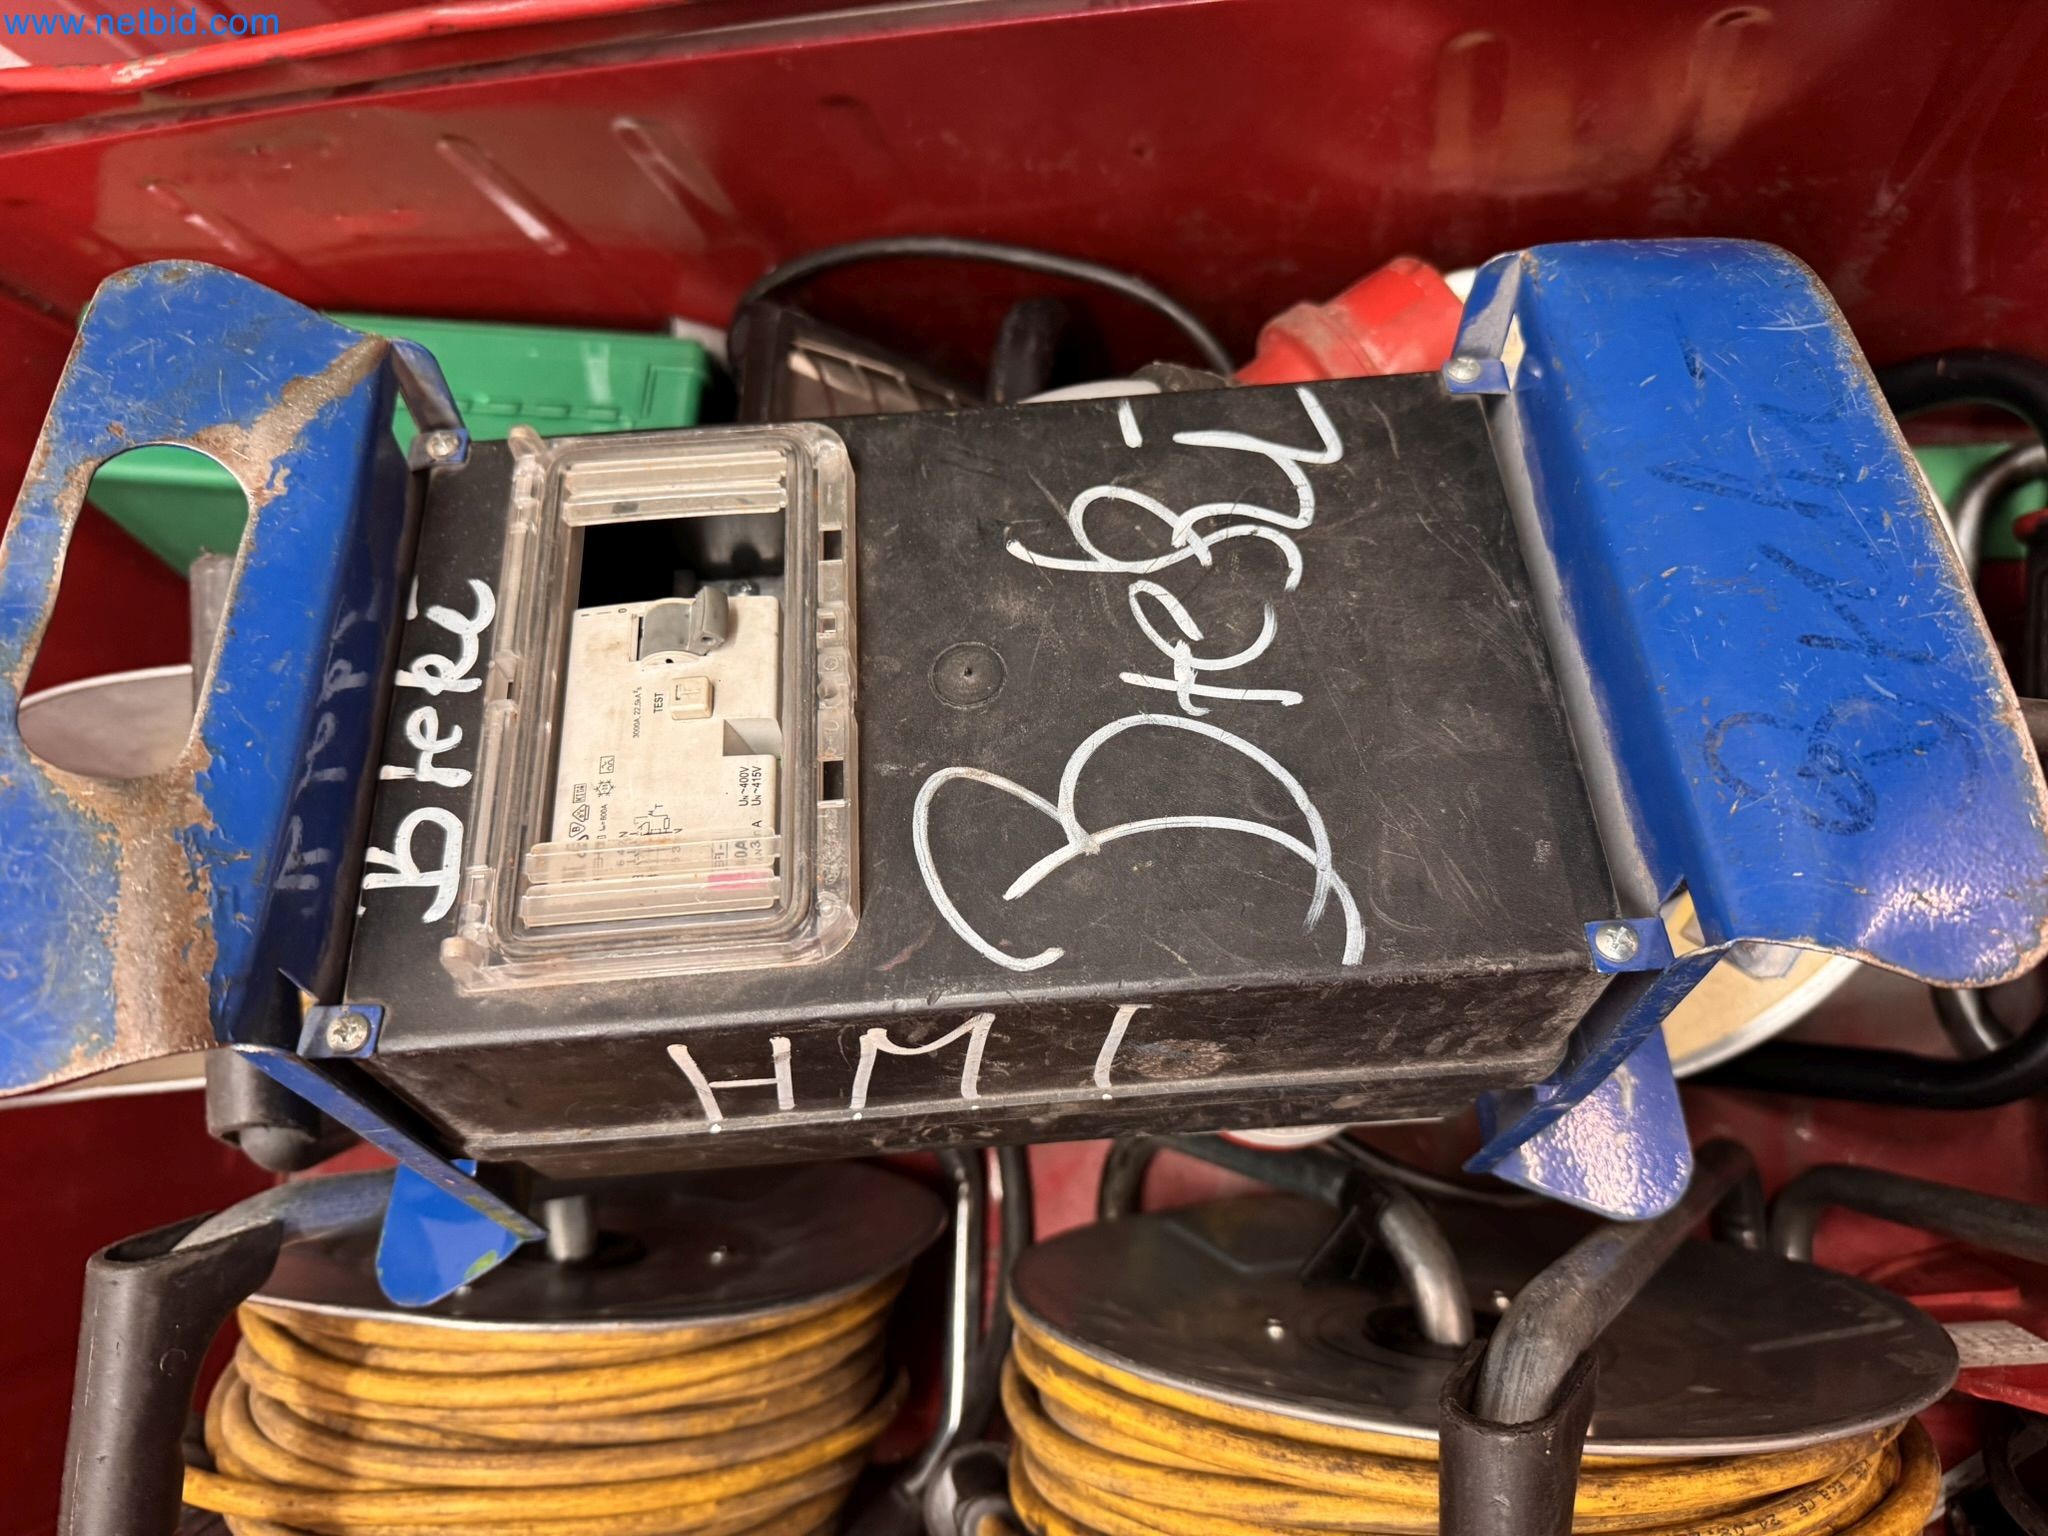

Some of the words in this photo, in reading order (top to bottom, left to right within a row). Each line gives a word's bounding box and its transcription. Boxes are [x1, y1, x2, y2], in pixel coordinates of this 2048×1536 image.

[361, 574, 497, 924] Breki
[653, 692, 664, 714] TEST
[913, 386, 1366, 972] Breki
